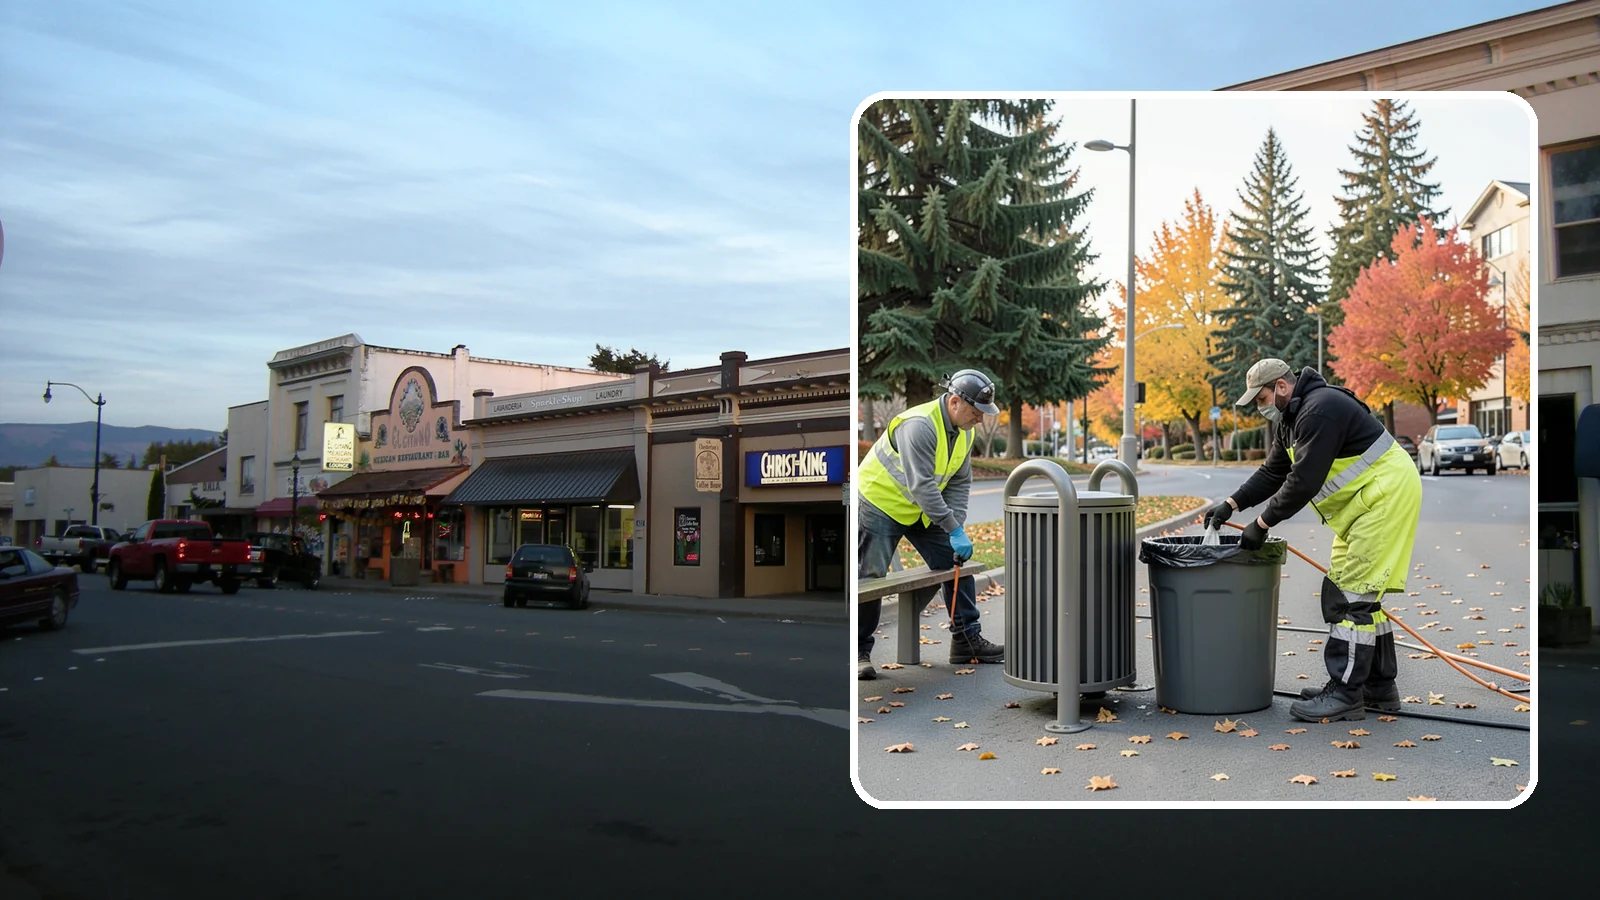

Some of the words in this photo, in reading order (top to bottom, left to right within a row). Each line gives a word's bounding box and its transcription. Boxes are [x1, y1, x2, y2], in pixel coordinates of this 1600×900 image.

[595, 389, 624, 400] LAUNDRY
[494, 402, 523, 413] LAVANDERIA
[373, 455, 396, 464] MEXICAN
[397, 452, 433, 462] RESTAURANT
[437, 450, 450, 459] BAR
[761, 452, 797, 478] CHRIST
[799, 450, 827, 477] KING
